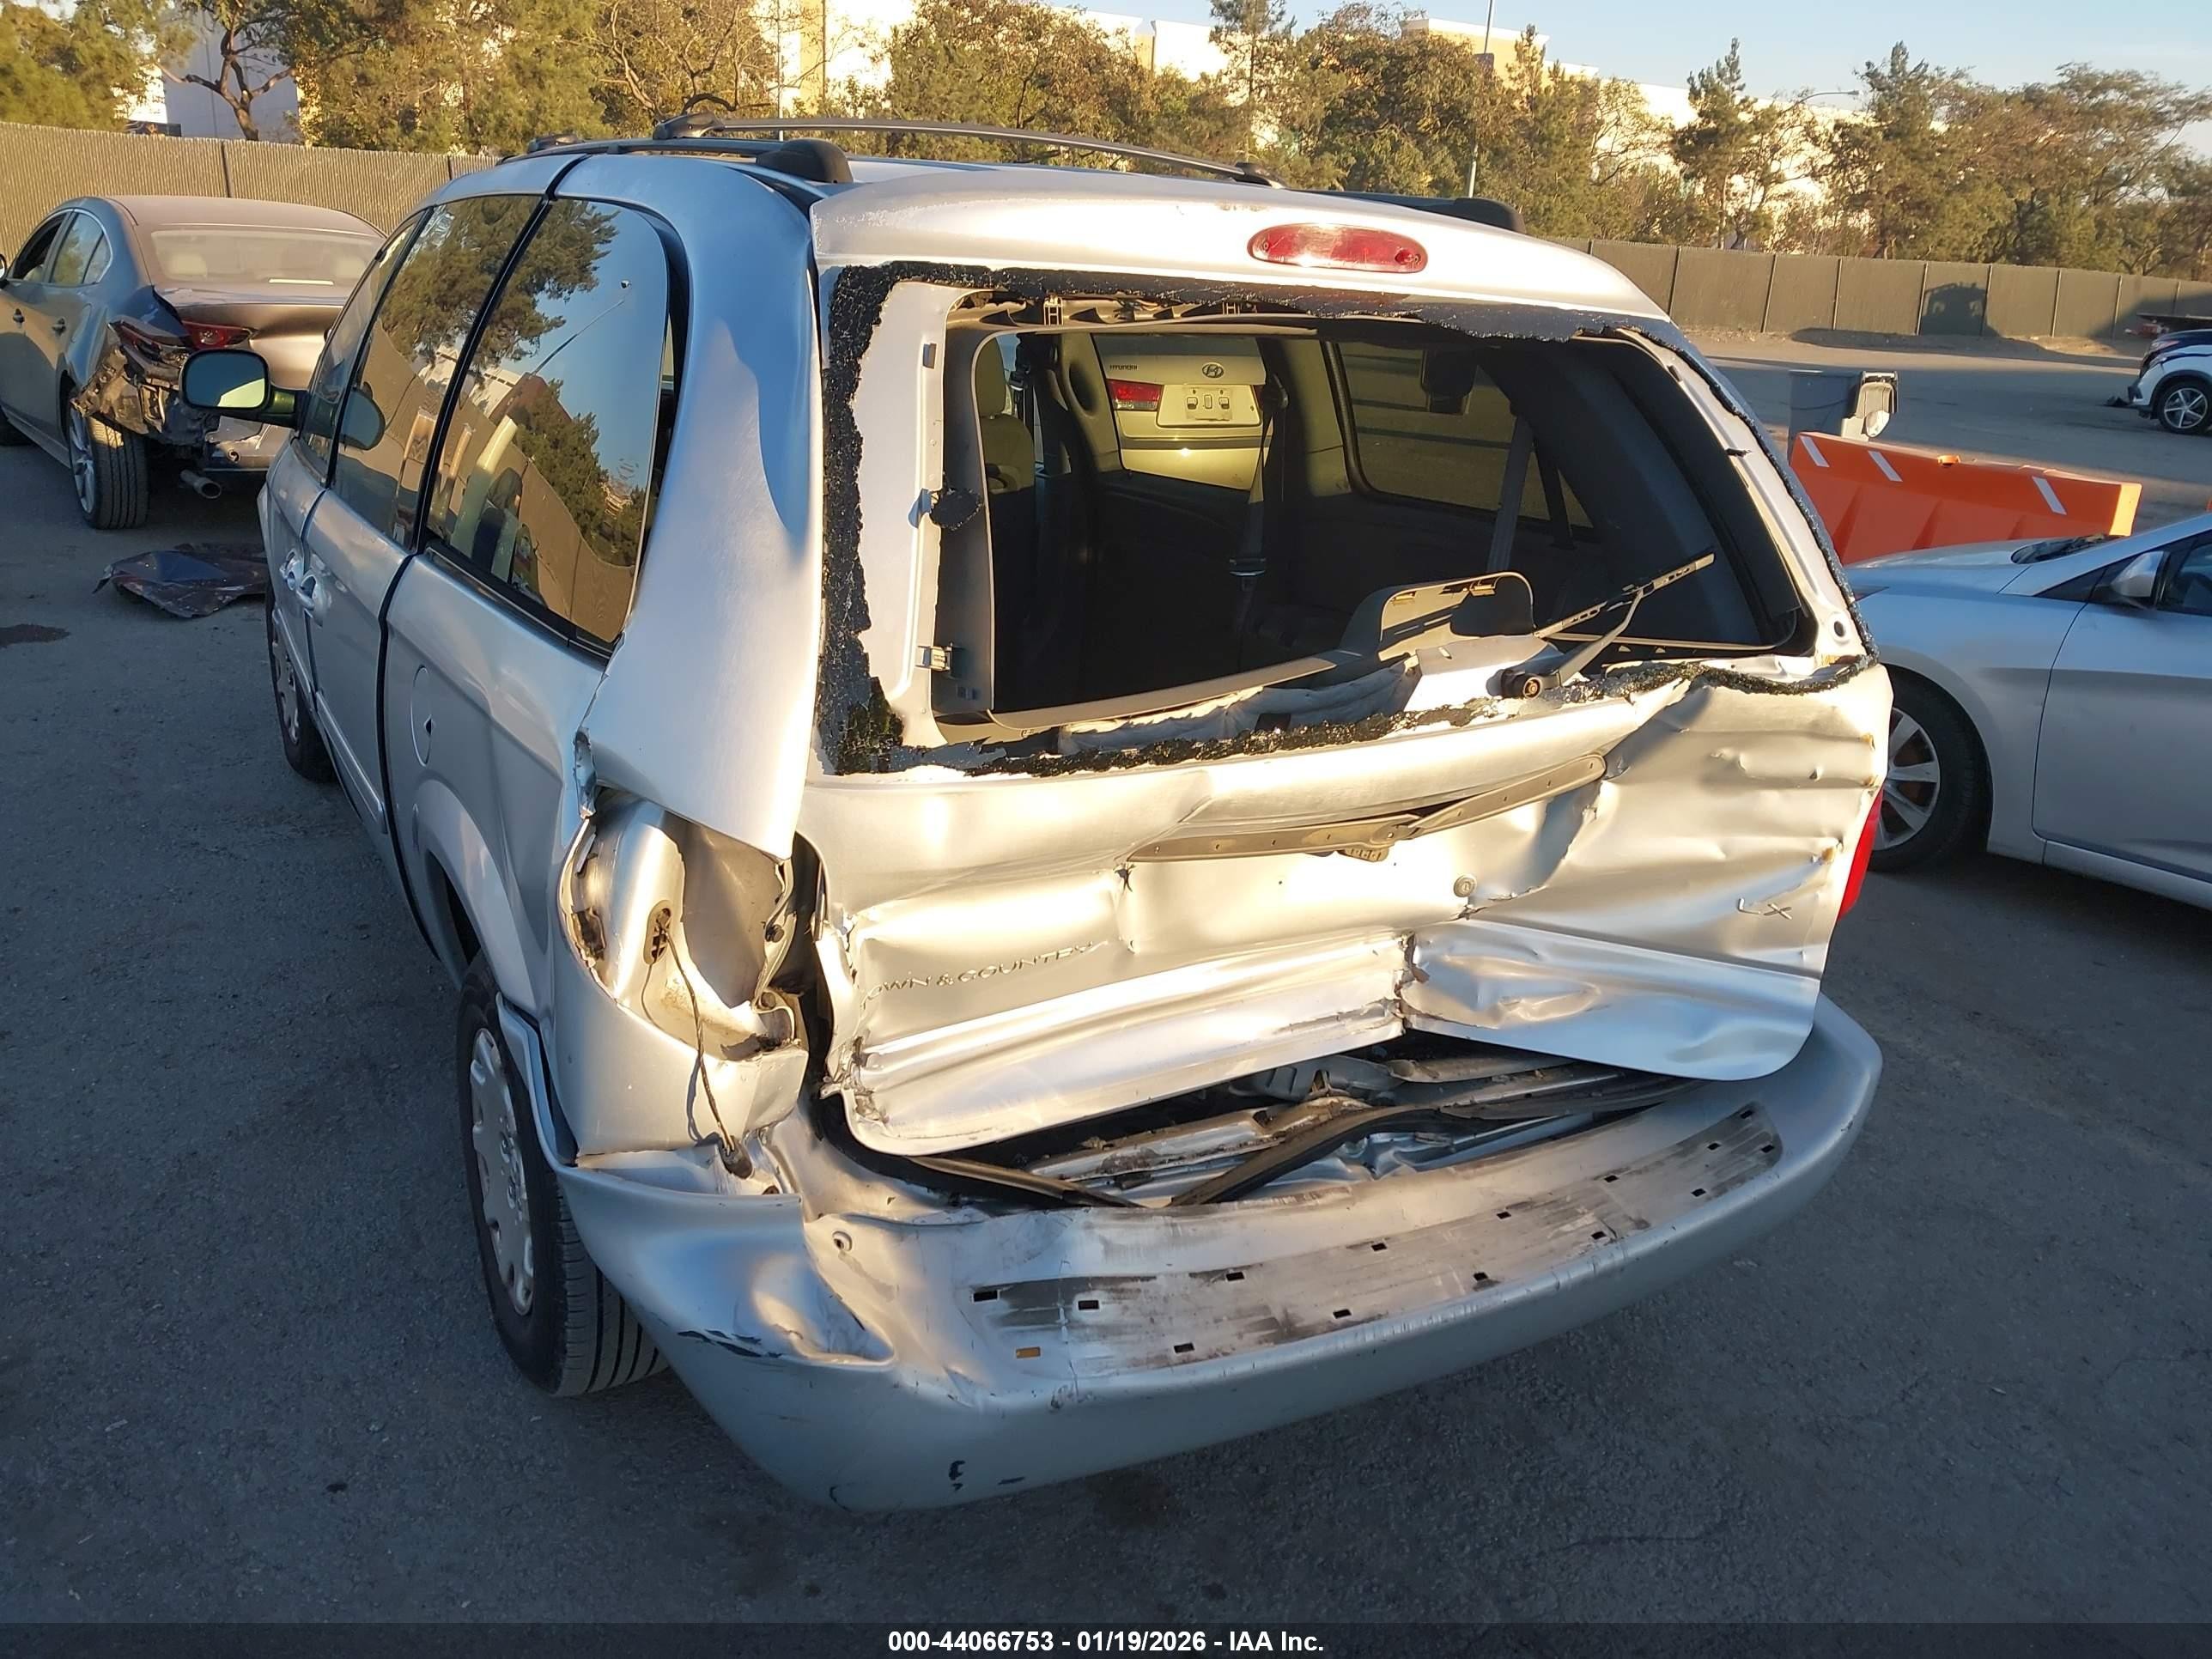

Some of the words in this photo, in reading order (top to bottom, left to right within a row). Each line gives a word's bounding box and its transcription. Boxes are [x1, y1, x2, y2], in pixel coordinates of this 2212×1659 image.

[1736, 897, 1793, 920] LX
[937, 972, 954, 987] &
[957, 941, 1093, 982] COUNTRY
